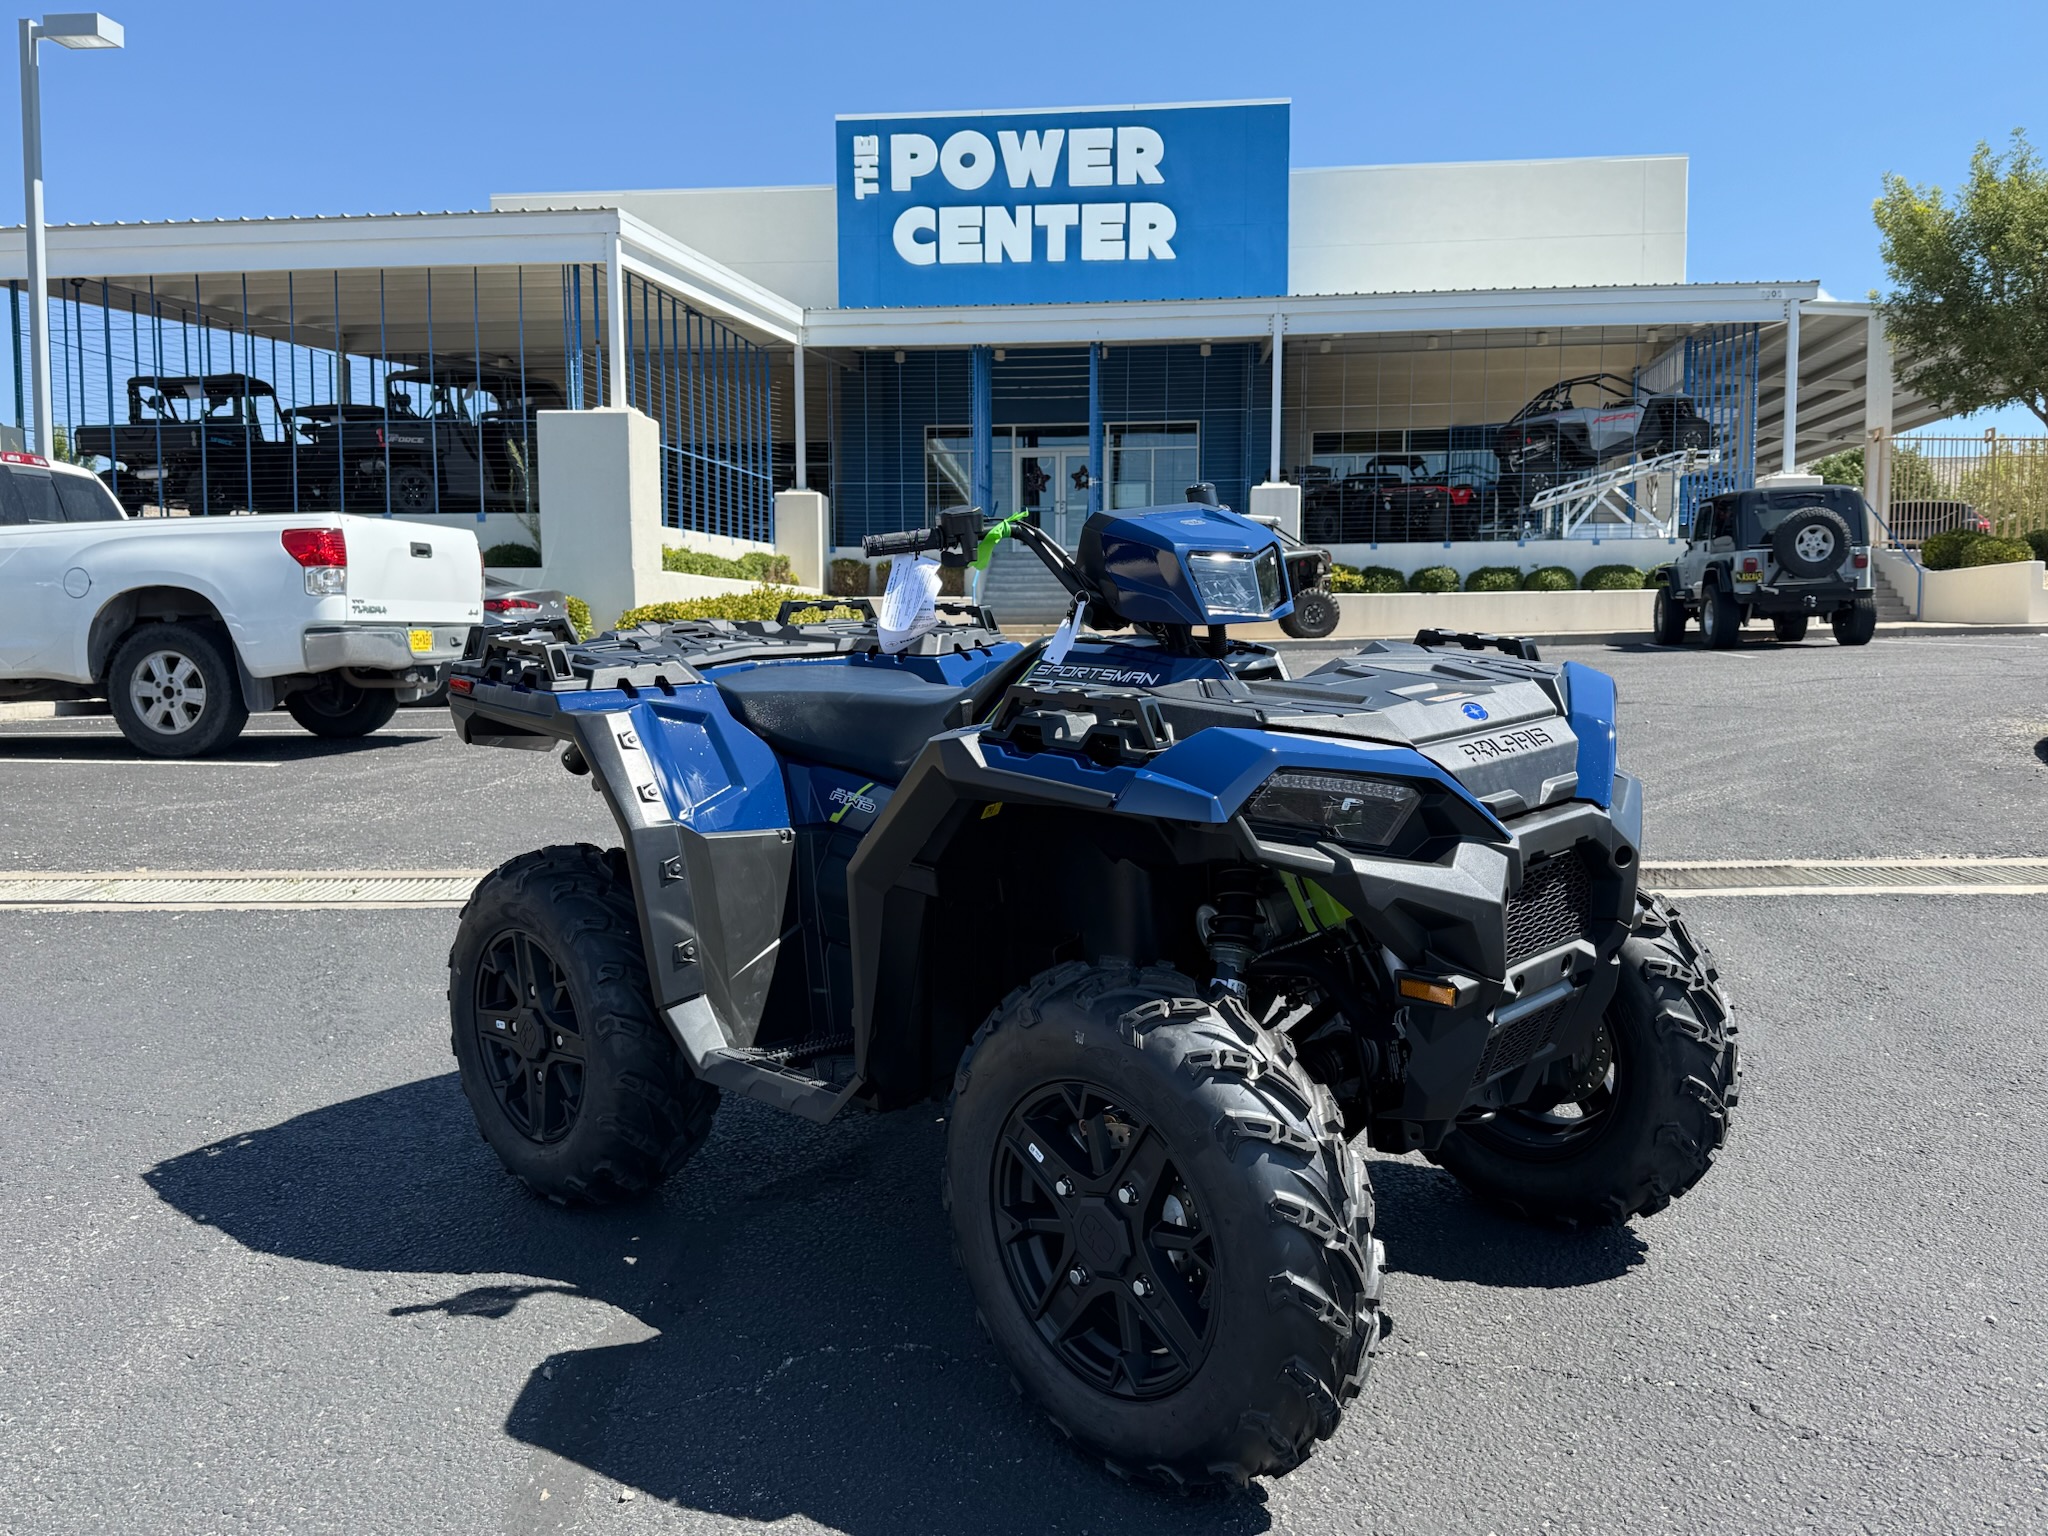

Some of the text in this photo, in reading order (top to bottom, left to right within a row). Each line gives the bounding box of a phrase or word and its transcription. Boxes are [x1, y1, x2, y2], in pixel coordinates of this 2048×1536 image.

[854, 135, 880, 201] THE
[890, 126, 1166, 192] POWER
[892, 202, 1178, 266] CENTER
[351, 605, 388, 614] TUNDRA
[1033, 663, 1161, 686] SPORTSMAN
[1458, 727, 1554, 762] POLARIS
[829, 789, 877, 814] AWD
